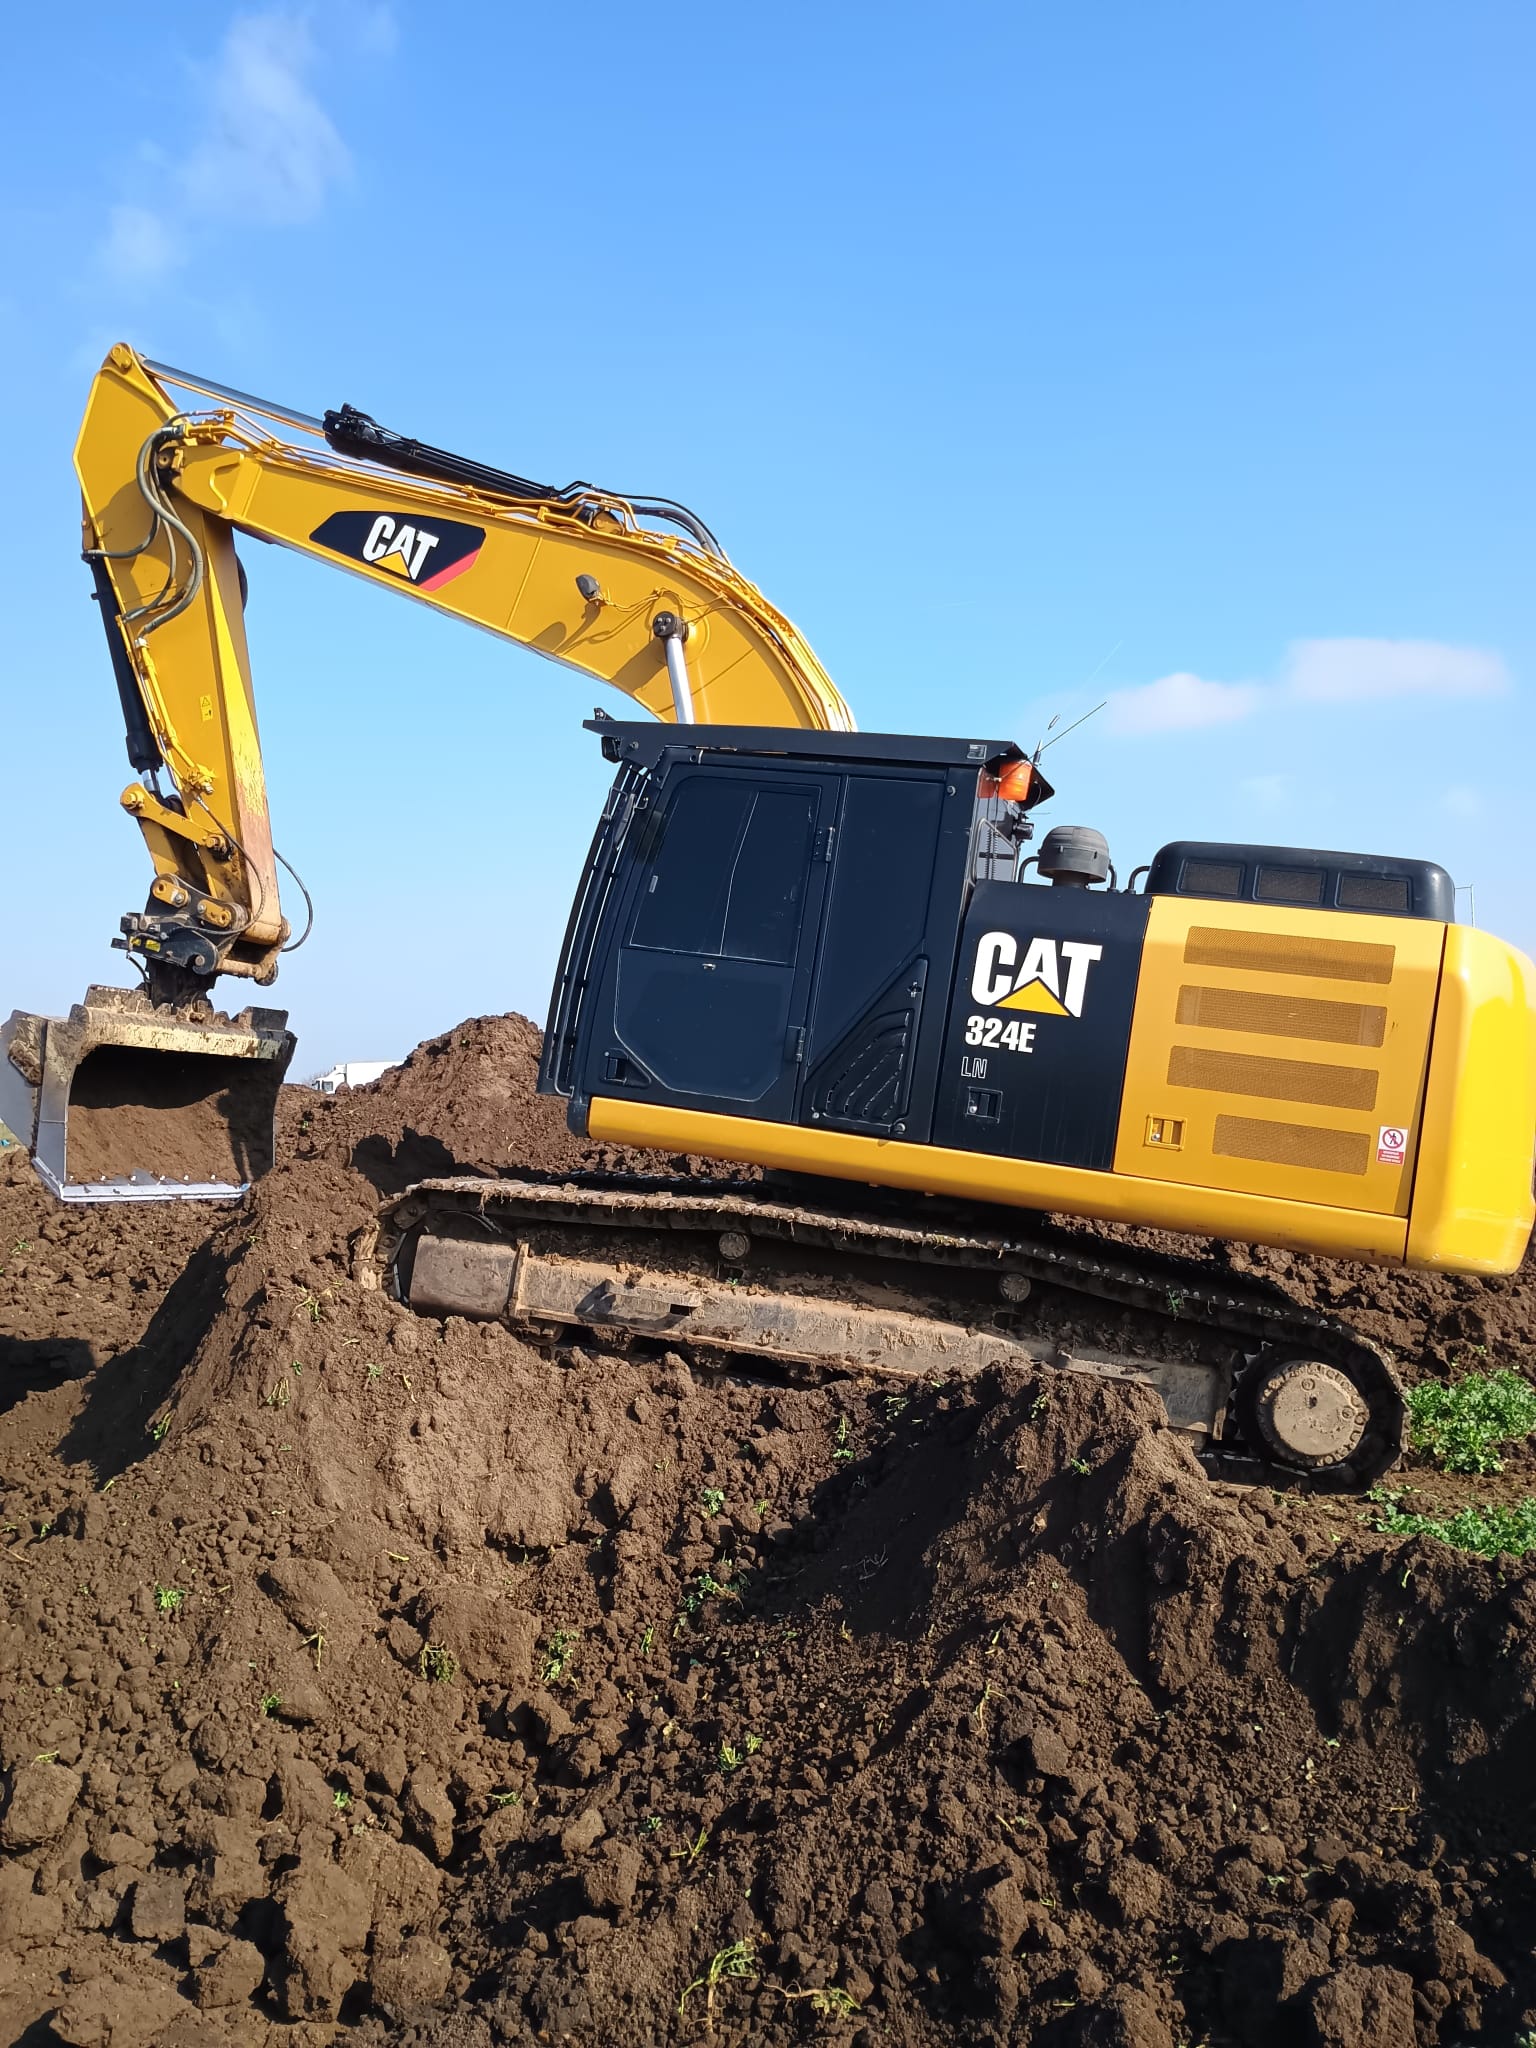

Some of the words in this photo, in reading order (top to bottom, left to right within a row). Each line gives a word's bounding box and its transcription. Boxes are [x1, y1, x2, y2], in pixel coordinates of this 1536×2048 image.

[362, 515, 440, 581] CAT
[971, 931, 1103, 1018] CAT
[964, 1015, 1037, 1053] 324E
[960, 1056, 988, 1079] LN
